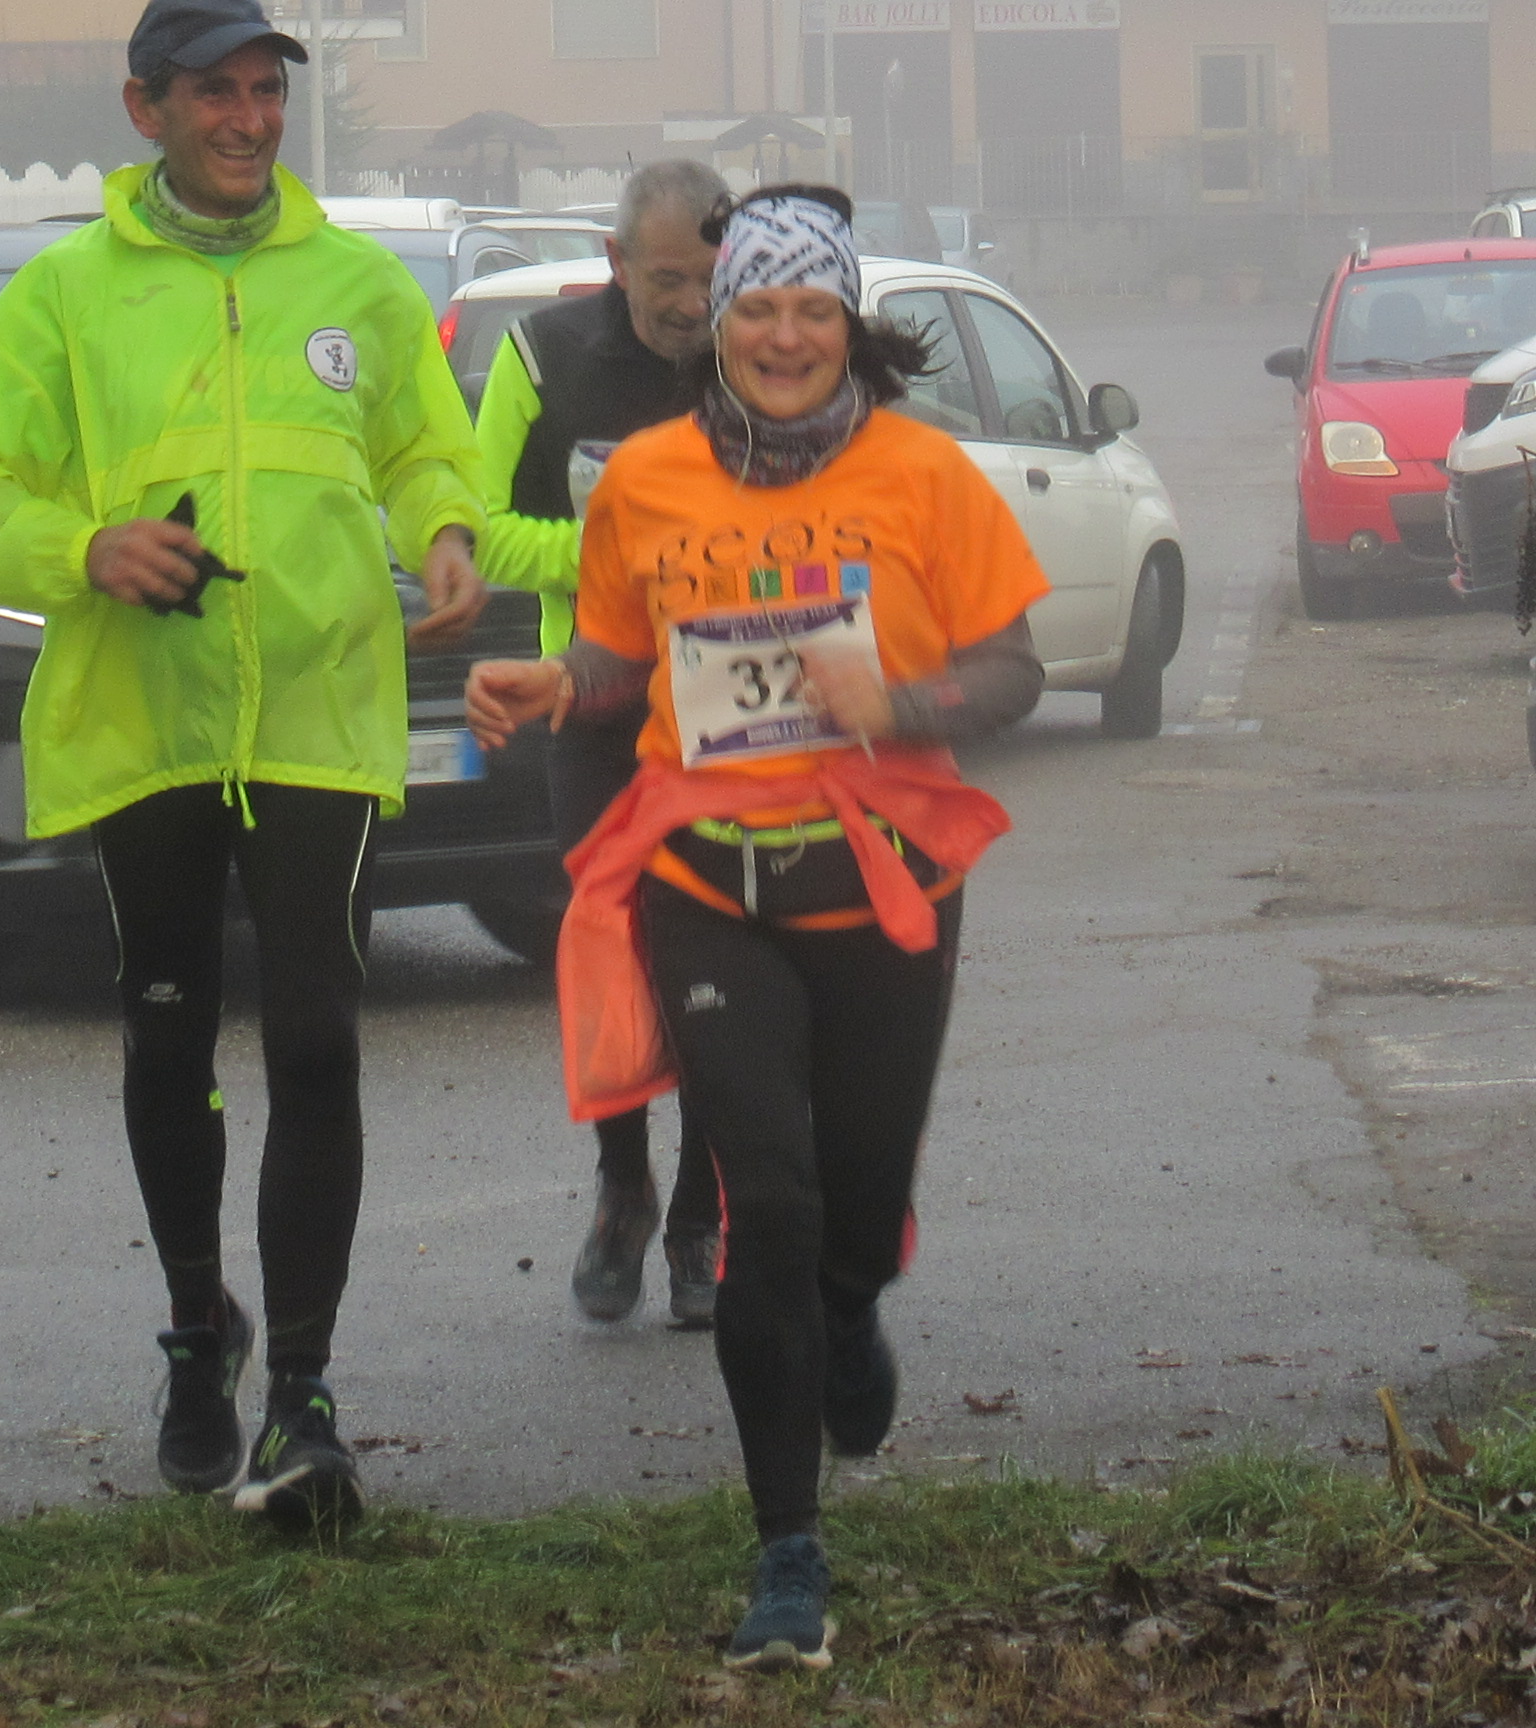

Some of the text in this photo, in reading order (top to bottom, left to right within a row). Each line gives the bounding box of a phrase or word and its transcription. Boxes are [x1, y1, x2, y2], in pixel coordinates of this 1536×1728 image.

[836, 2, 946, 27] BAR JOLLY
[978, 4, 1078, 24] EDICOLA
